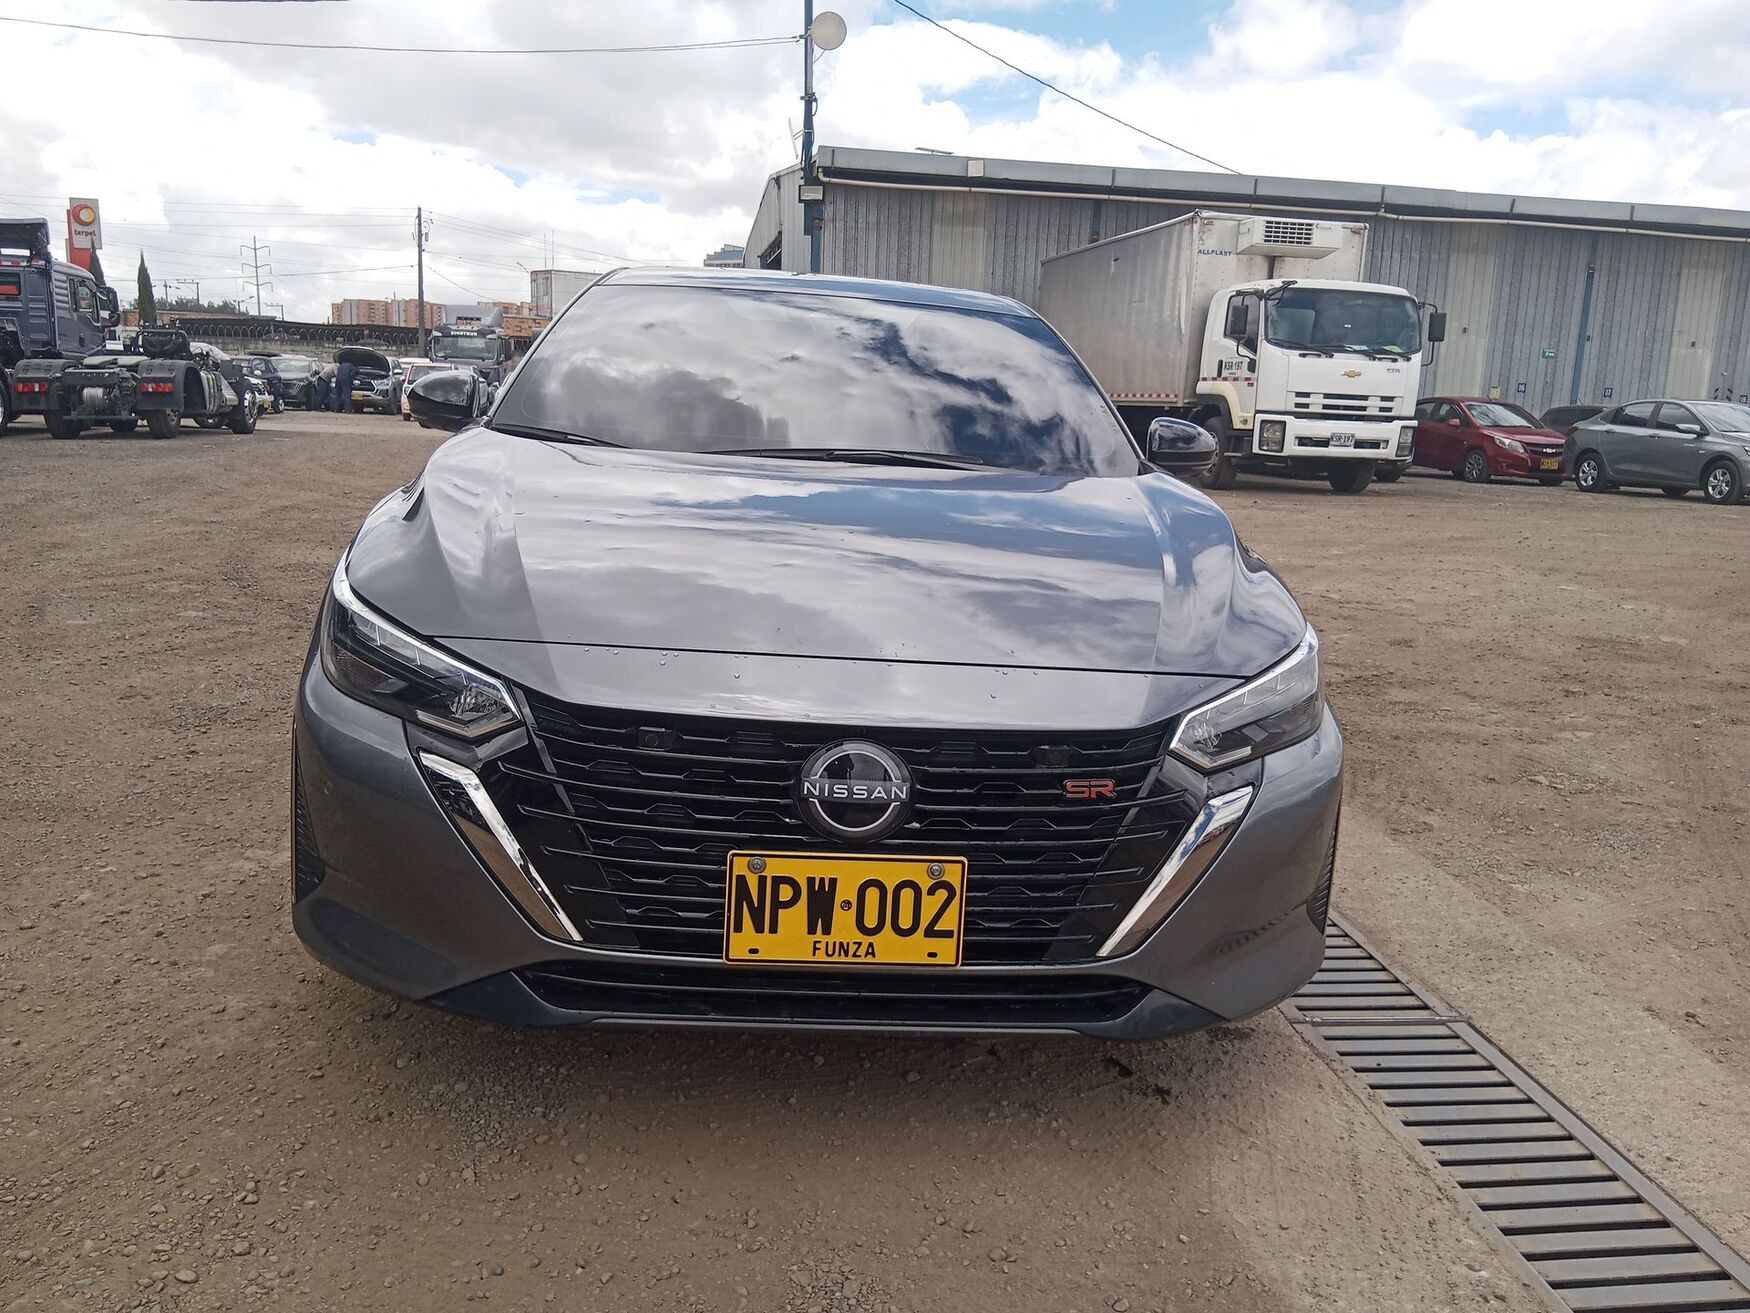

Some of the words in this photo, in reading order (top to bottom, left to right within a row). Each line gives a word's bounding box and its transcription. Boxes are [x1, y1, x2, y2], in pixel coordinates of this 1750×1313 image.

[74, 229, 96, 237] terpel
[1198, 248, 1232, 256] ALLPLAST
[803, 781, 907, 799] NISSAN
[1065, 780, 1115, 798] SR
[812, 940, 876, 958] FUNZA
